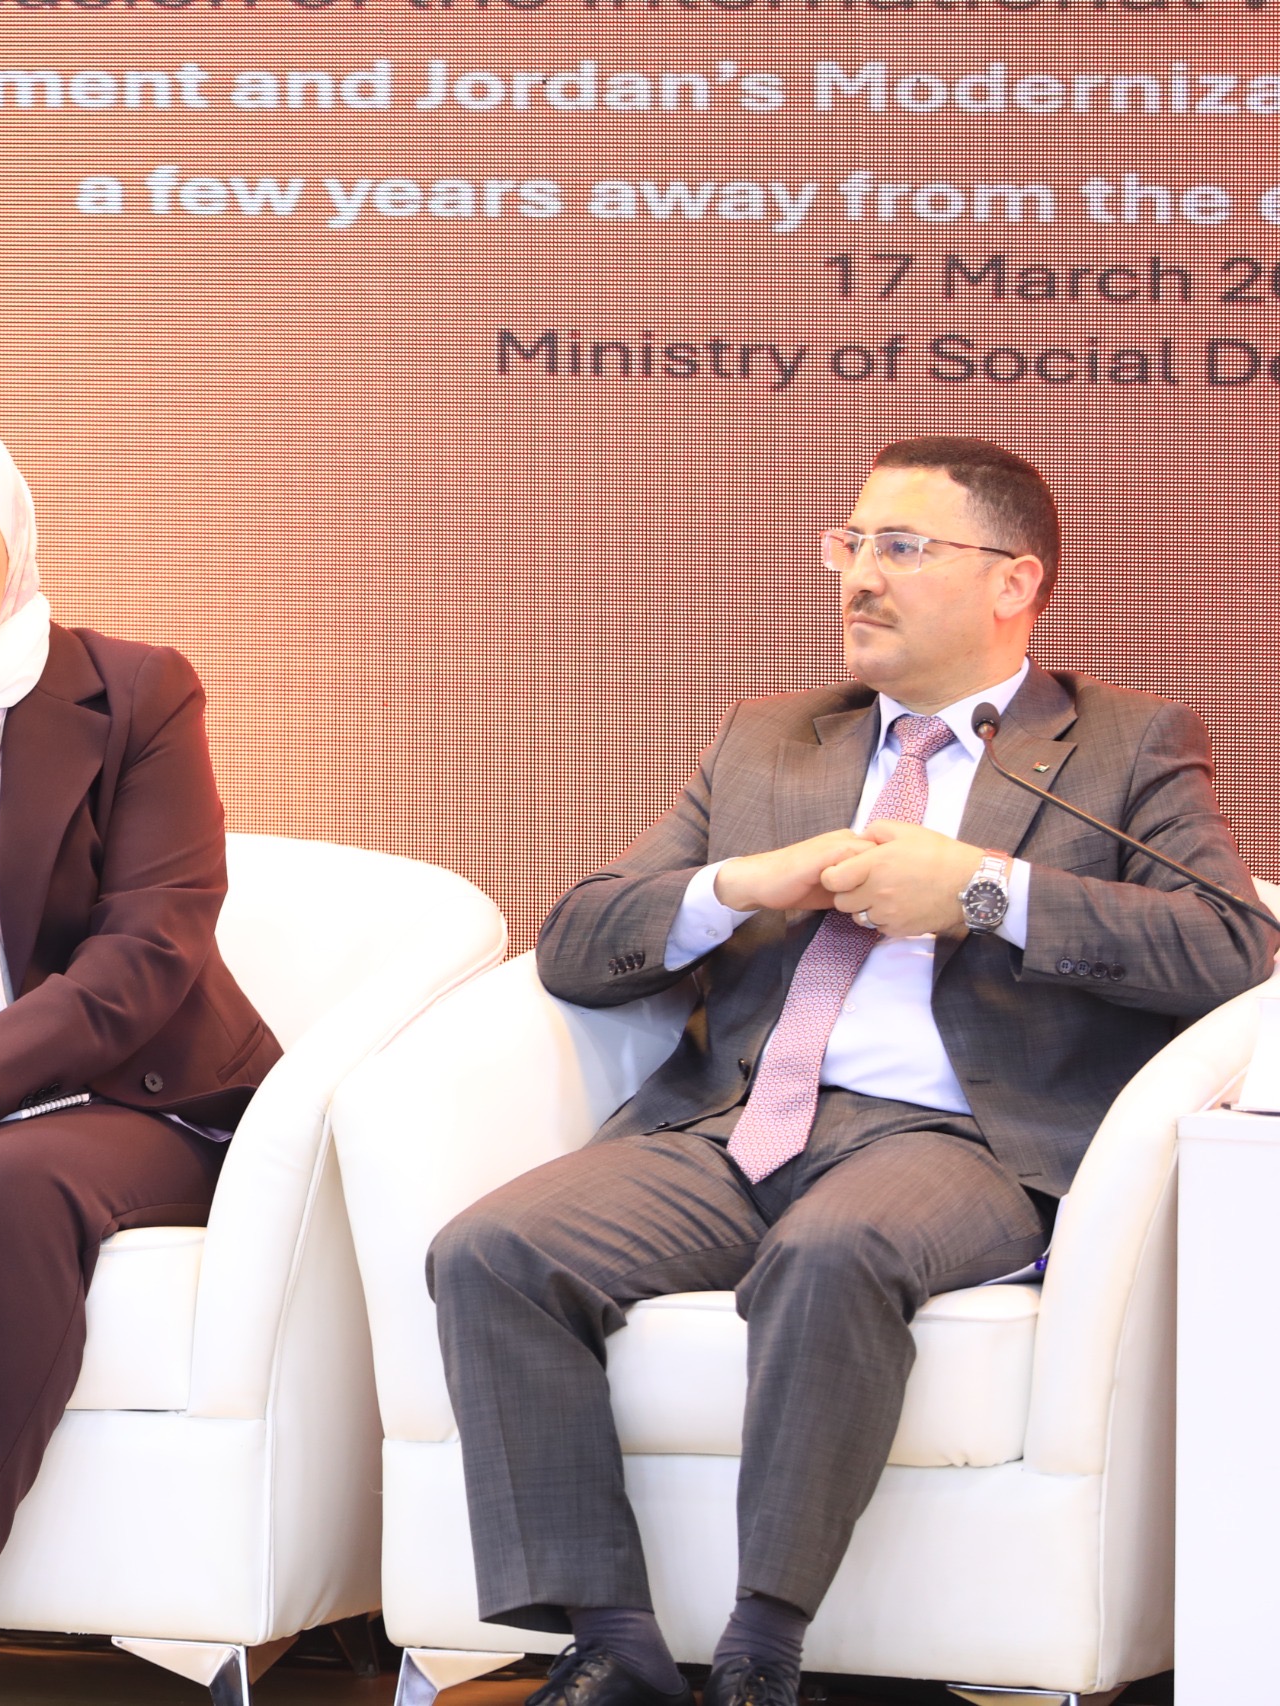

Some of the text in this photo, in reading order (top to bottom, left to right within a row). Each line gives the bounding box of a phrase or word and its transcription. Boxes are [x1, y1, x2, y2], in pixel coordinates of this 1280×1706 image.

[231, 58, 391, 109] and
[415, 58, 786, 112] Jordan's
[76, 175, 124, 215] a
[145, 164, 304, 216] few
[324, 177, 563, 230] years
[587, 178, 819, 234] away
[838, 169, 1056, 224] from
[1081, 171, 1232, 226] the
[823, 252, 1280, 304] 17 March 2
[496, 328, 1280, 391] Ministry of Social D
